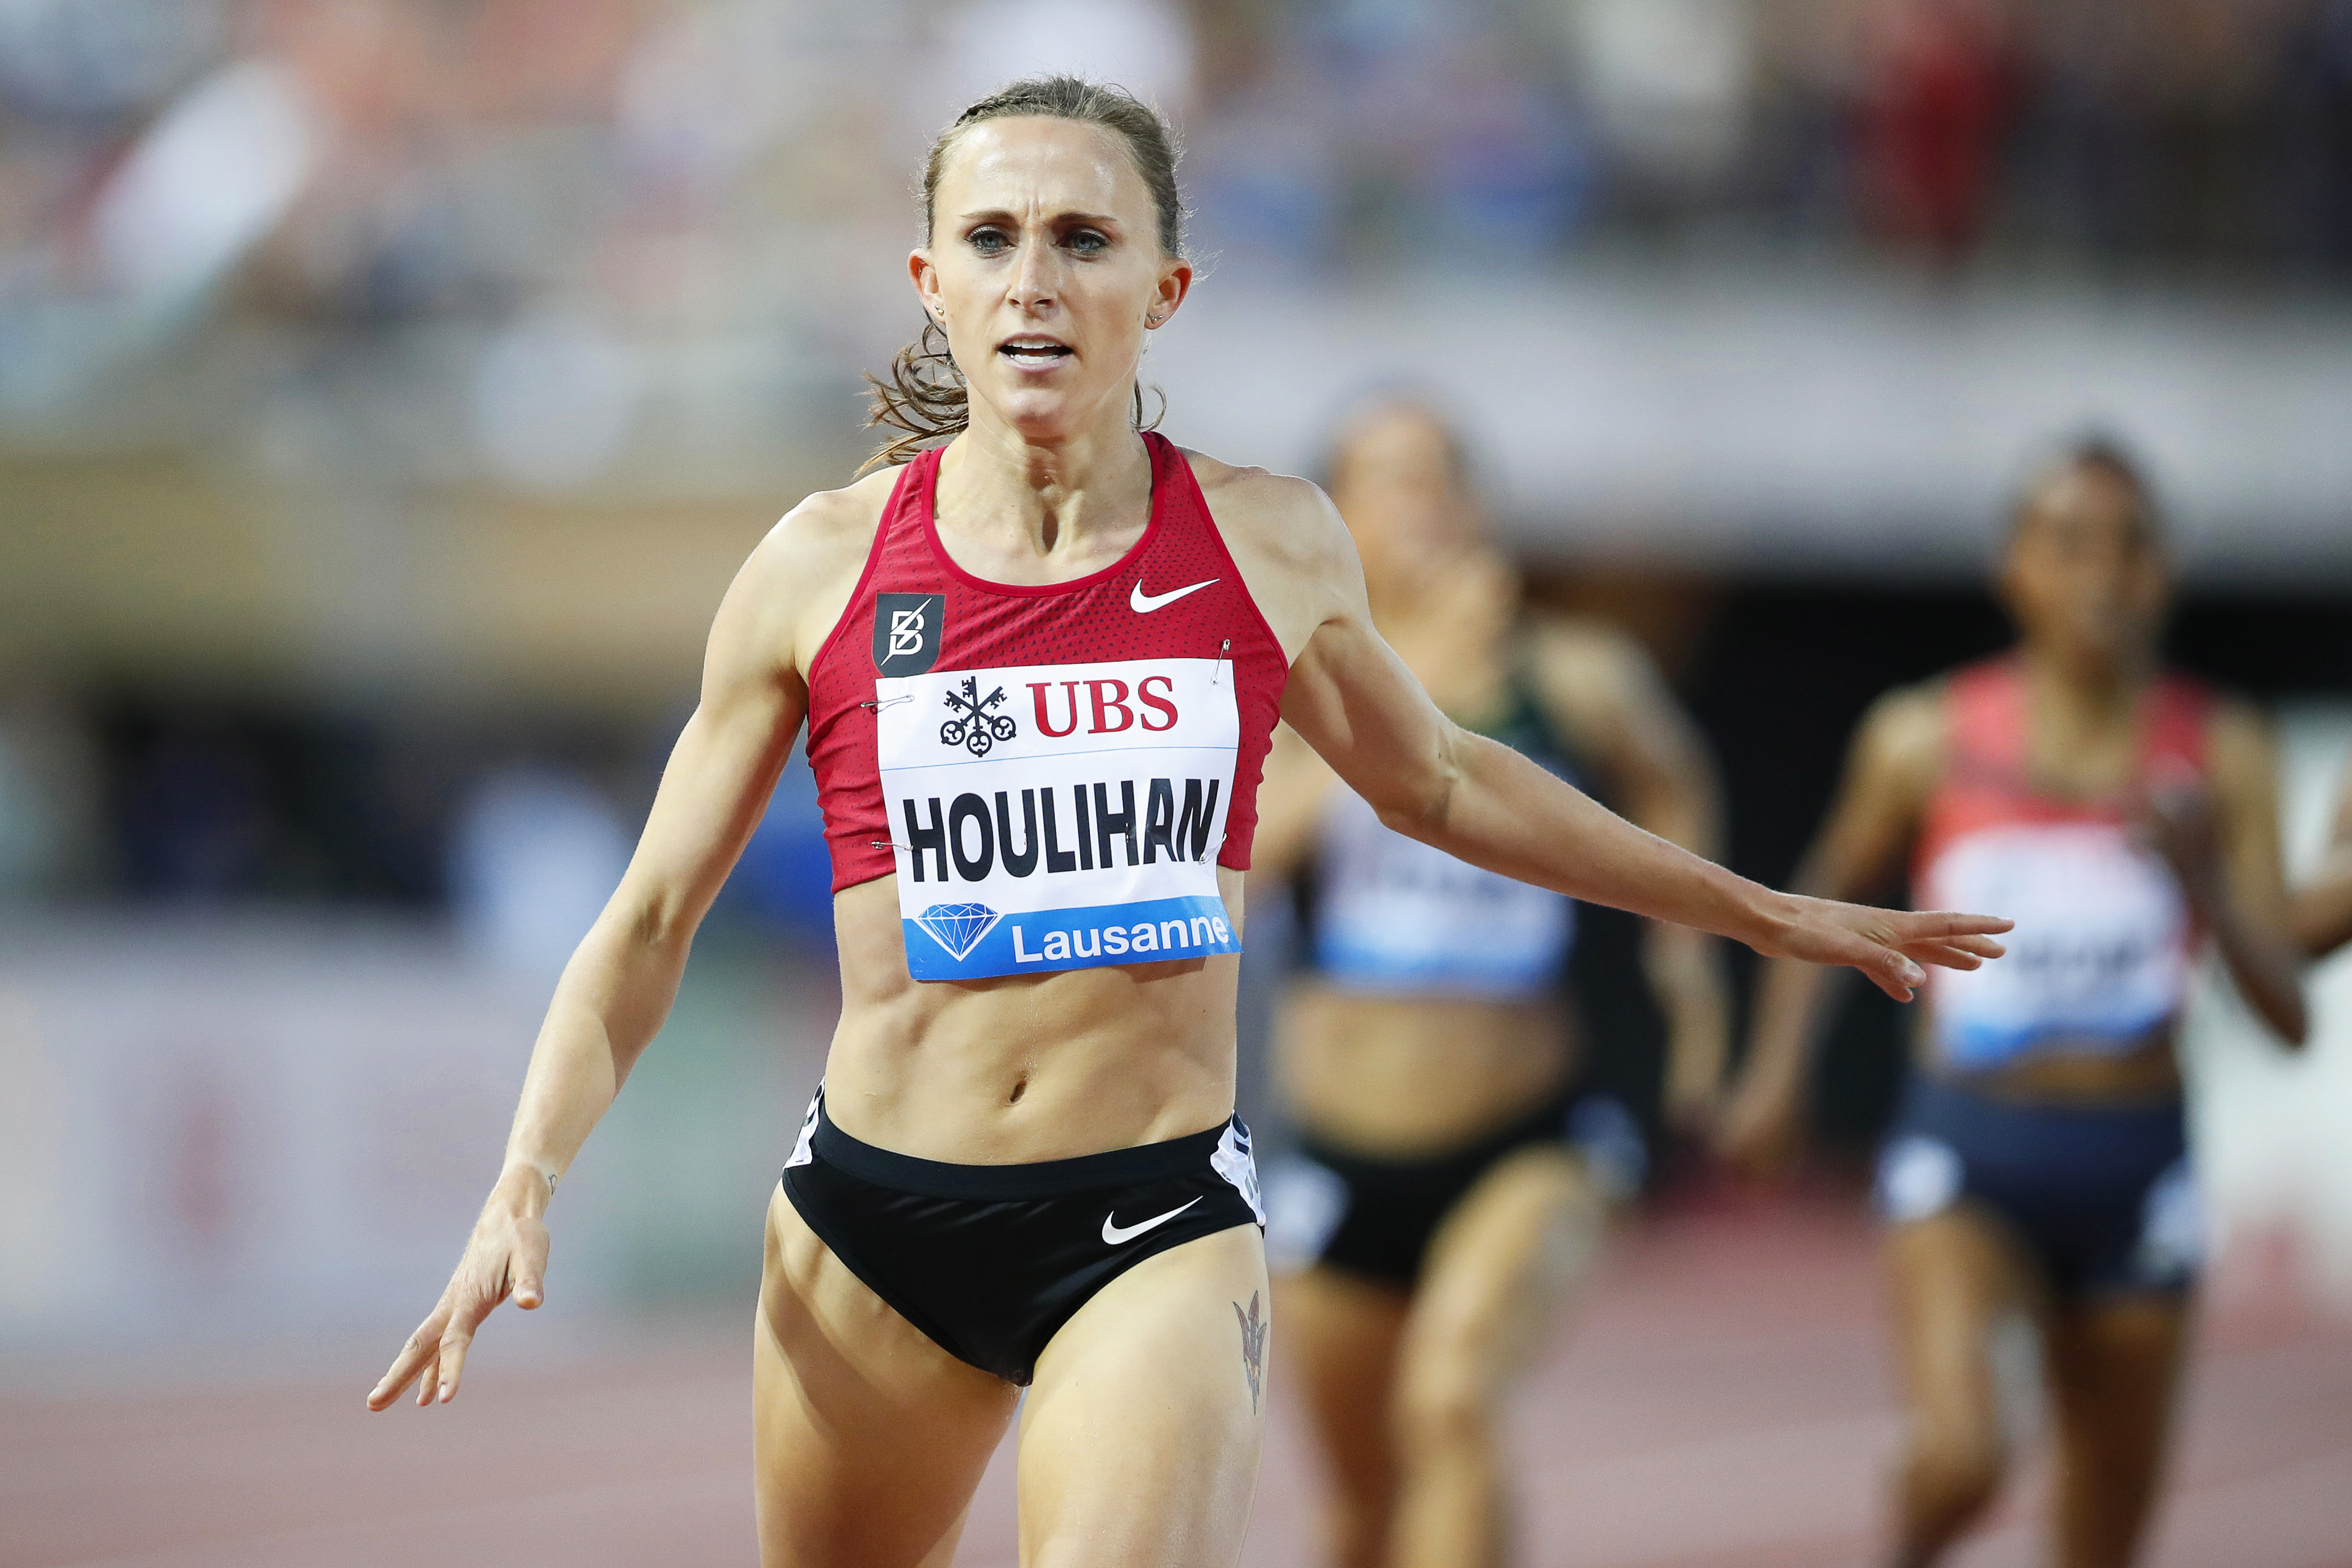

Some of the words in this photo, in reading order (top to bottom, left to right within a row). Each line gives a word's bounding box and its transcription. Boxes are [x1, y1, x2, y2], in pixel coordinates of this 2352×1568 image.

[1026, 676, 1178, 737] UBS
[903, 778, 1220, 882] HOULIHAN
[1012, 915, 1230, 963] Lausanne
